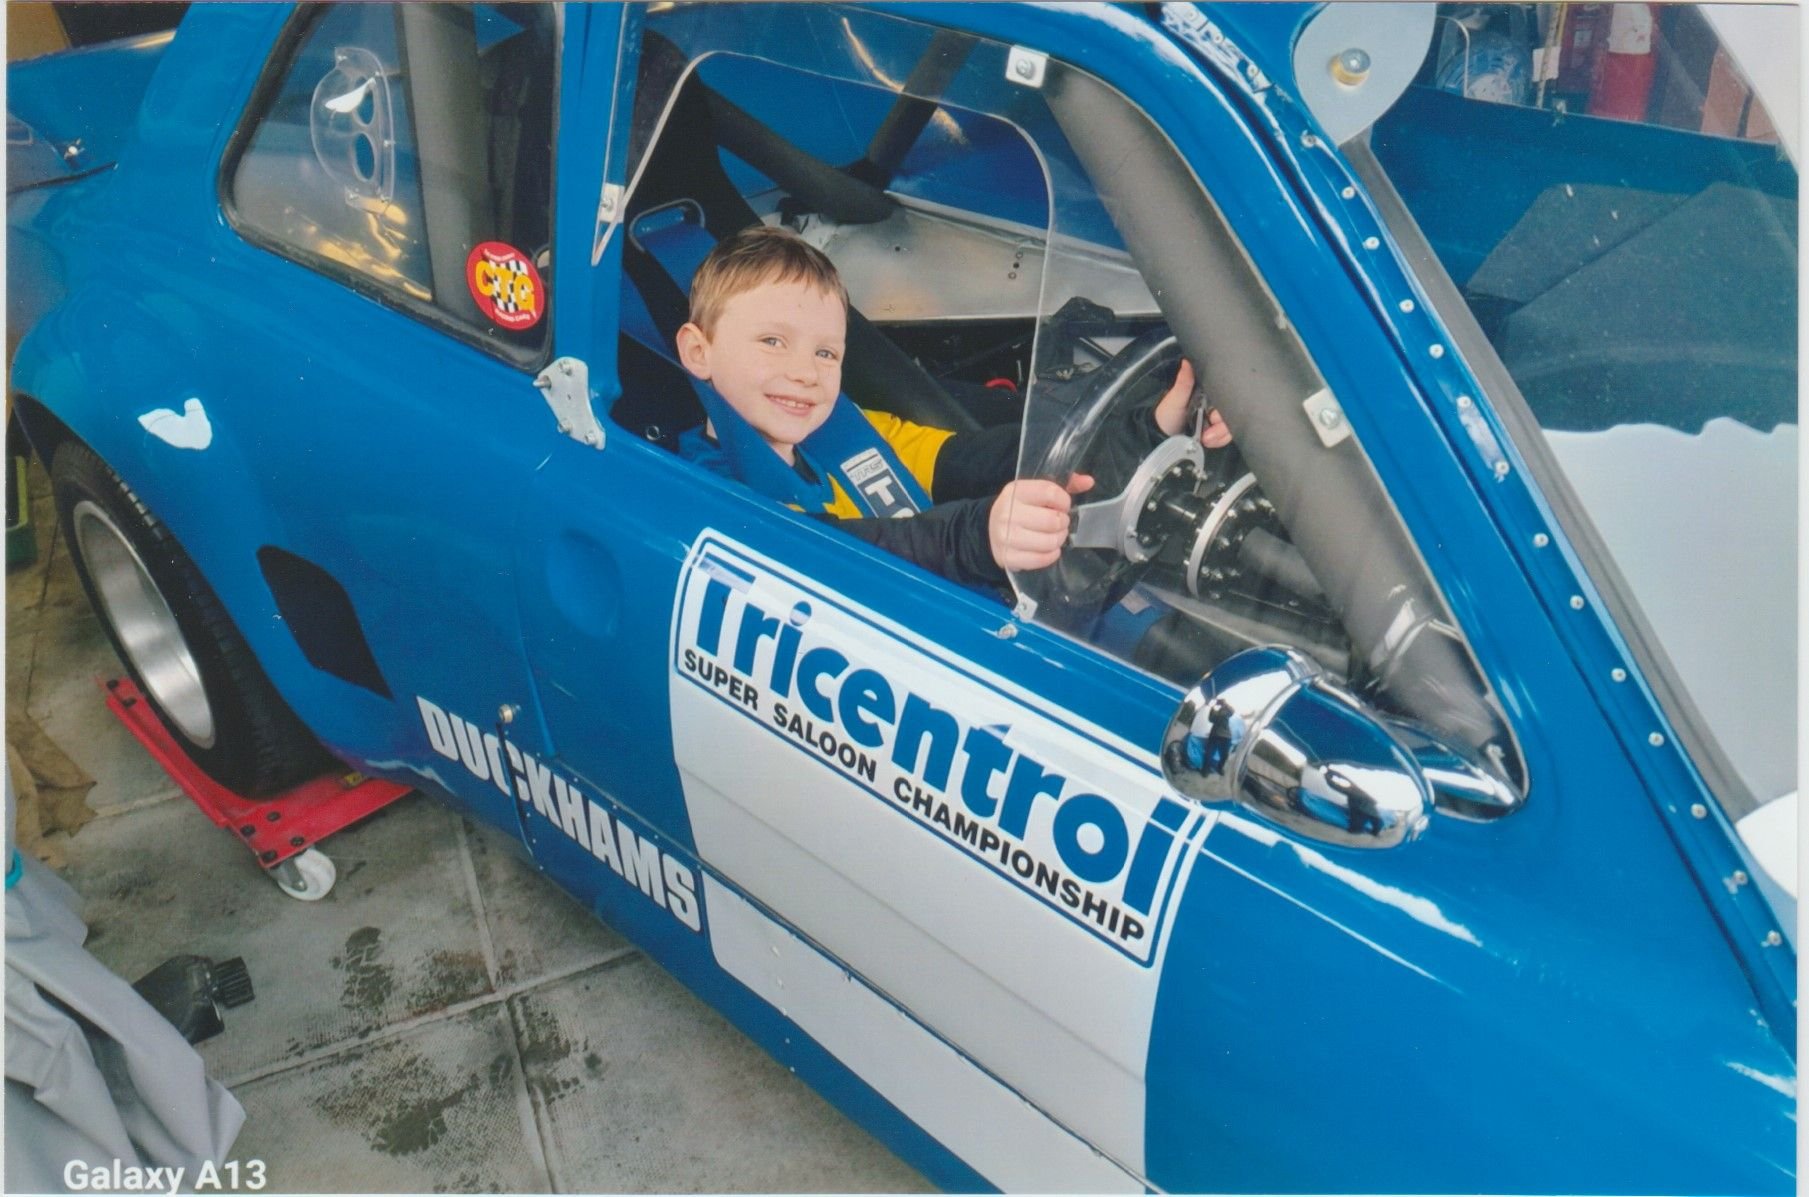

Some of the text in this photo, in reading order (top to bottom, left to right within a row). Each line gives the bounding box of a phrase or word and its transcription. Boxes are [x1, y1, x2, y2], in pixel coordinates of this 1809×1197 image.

[475, 260, 535, 312] CTG
[416, 696, 701, 932] DUCKHAMS
[684, 648, 1145, 941] SUPER SALOON CHAMPIONSHIP
[696, 551, 1191, 917] Tricentrol
